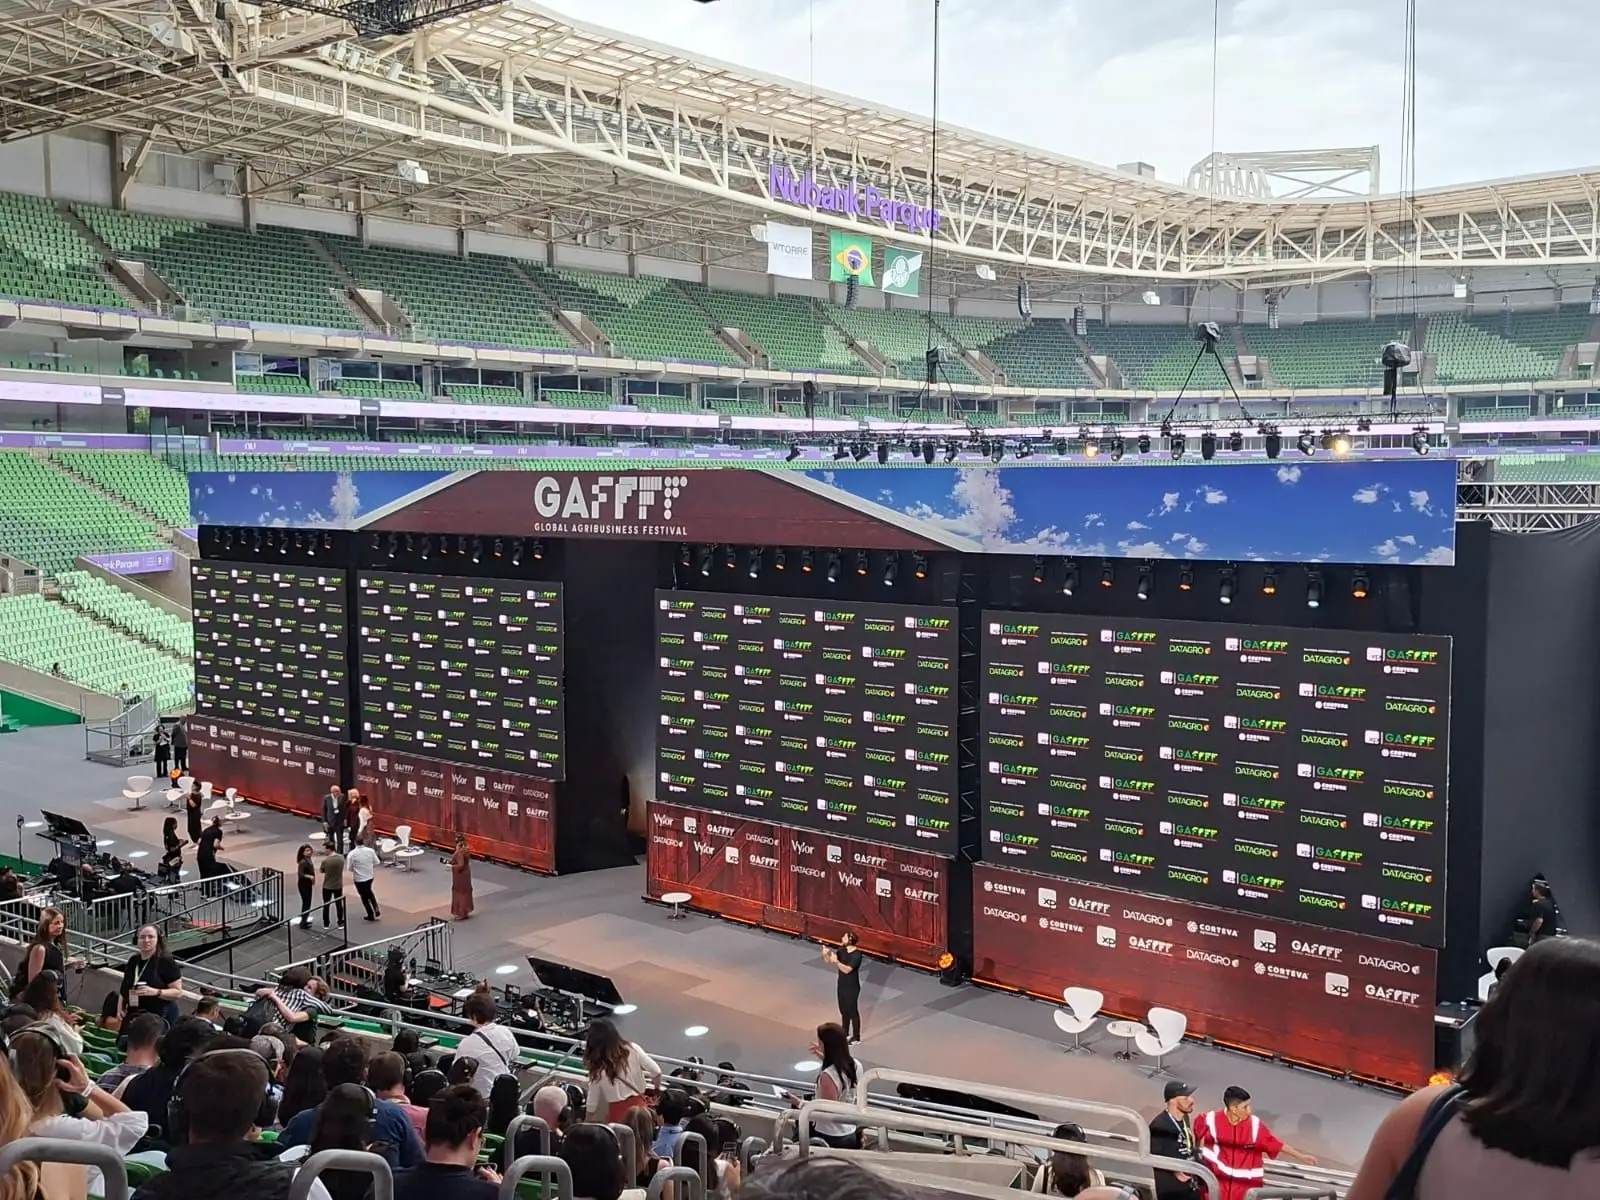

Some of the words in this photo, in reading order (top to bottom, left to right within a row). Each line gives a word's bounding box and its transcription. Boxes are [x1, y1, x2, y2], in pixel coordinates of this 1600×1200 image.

[770, 163, 862, 216] Nubank
[866, 186, 941, 232] Parque
[534, 522, 568, 532] GLOBAL
[572, 523, 639, 535] AGRIBUSINESS
[642, 525, 688, 536] FESTIVAL
[115, 559, 139, 569] Parque
[865, 623, 889, 632] DATAGRO
[1050, 636, 1081, 646] DATAGRO
[1169, 644, 1203, 654] DATAGRO
[1386, 648, 1437, 661] GAFFFF
[823, 651, 846, 660] DATAGRO
[1303, 653, 1341, 664] DATAGRO
[917, 660, 943, 669] DATAGRO
[989, 667, 1017, 676] DATAGRO
[1105, 677, 1137, 687] DATAGRO
[865, 687, 890, 697] DATAGRO
[1236, 688, 1272, 699] DATAGRO
[1050, 708, 1081, 718] DATAGRO
[1385, 701, 1427, 713] DATAGRO
[823, 714, 847, 724] DATAGRO
[917, 726, 943, 736] DATAGRO
[1168, 720, 1203, 731] DATAGRO
[989, 736, 1017, 746] DATAGRO
[1301, 734, 1340, 746] DATAGRO
[1384, 731, 1435, 747] GAFFFF
[866, 752, 890, 762] DATAGRO
[1105, 750, 1137, 761] DATAGRO
[1235, 766, 1271, 778] DATAGRO
[824, 777, 847, 787] DATAGRO
[1050, 779, 1081, 790] DATAGRO
[1383, 784, 1425, 797] DATAGRO
[918, 792, 944, 803] DATAGRO
[1168, 795, 1202, 808] DATAGRO
[989, 804, 1017, 816] DATAGRO
[866, 816, 891, 827] DATAGRO
[1300, 814, 1339, 827] DATAGRO
[1382, 814, 1433, 831] GAFFFF
[1104, 823, 1136, 835] DATAGRO
[1050, 849, 1080, 862] DATAGRO
[1234, 843, 1270, 857] DATAGRO
[900, 864, 933, 878] DATAGRO
[1167, 870, 1201, 883] DATAGRO
[1382, 866, 1423, 881] DATAGRO
[994, 883, 1026, 895] CORTEVA
[1299, 893, 1337, 908] DATAGRO
[1381, 896, 1431, 915] GAFFFF
[984, 907, 1020, 923] DATAGRO
[1123, 909, 1165, 926] DATAGRO
[1050, 920, 1084, 933] CORTEVA
[1199, 924, 1239, 937] CORTEVA
[1259, 941, 1277, 953] xp
[1187, 949, 1231, 967] DATAGRO
[1359, 955, 1410, 973] DATAGRO
[1267, 965, 1309, 980] CORTEVA
[1331, 984, 1349, 997] xp
